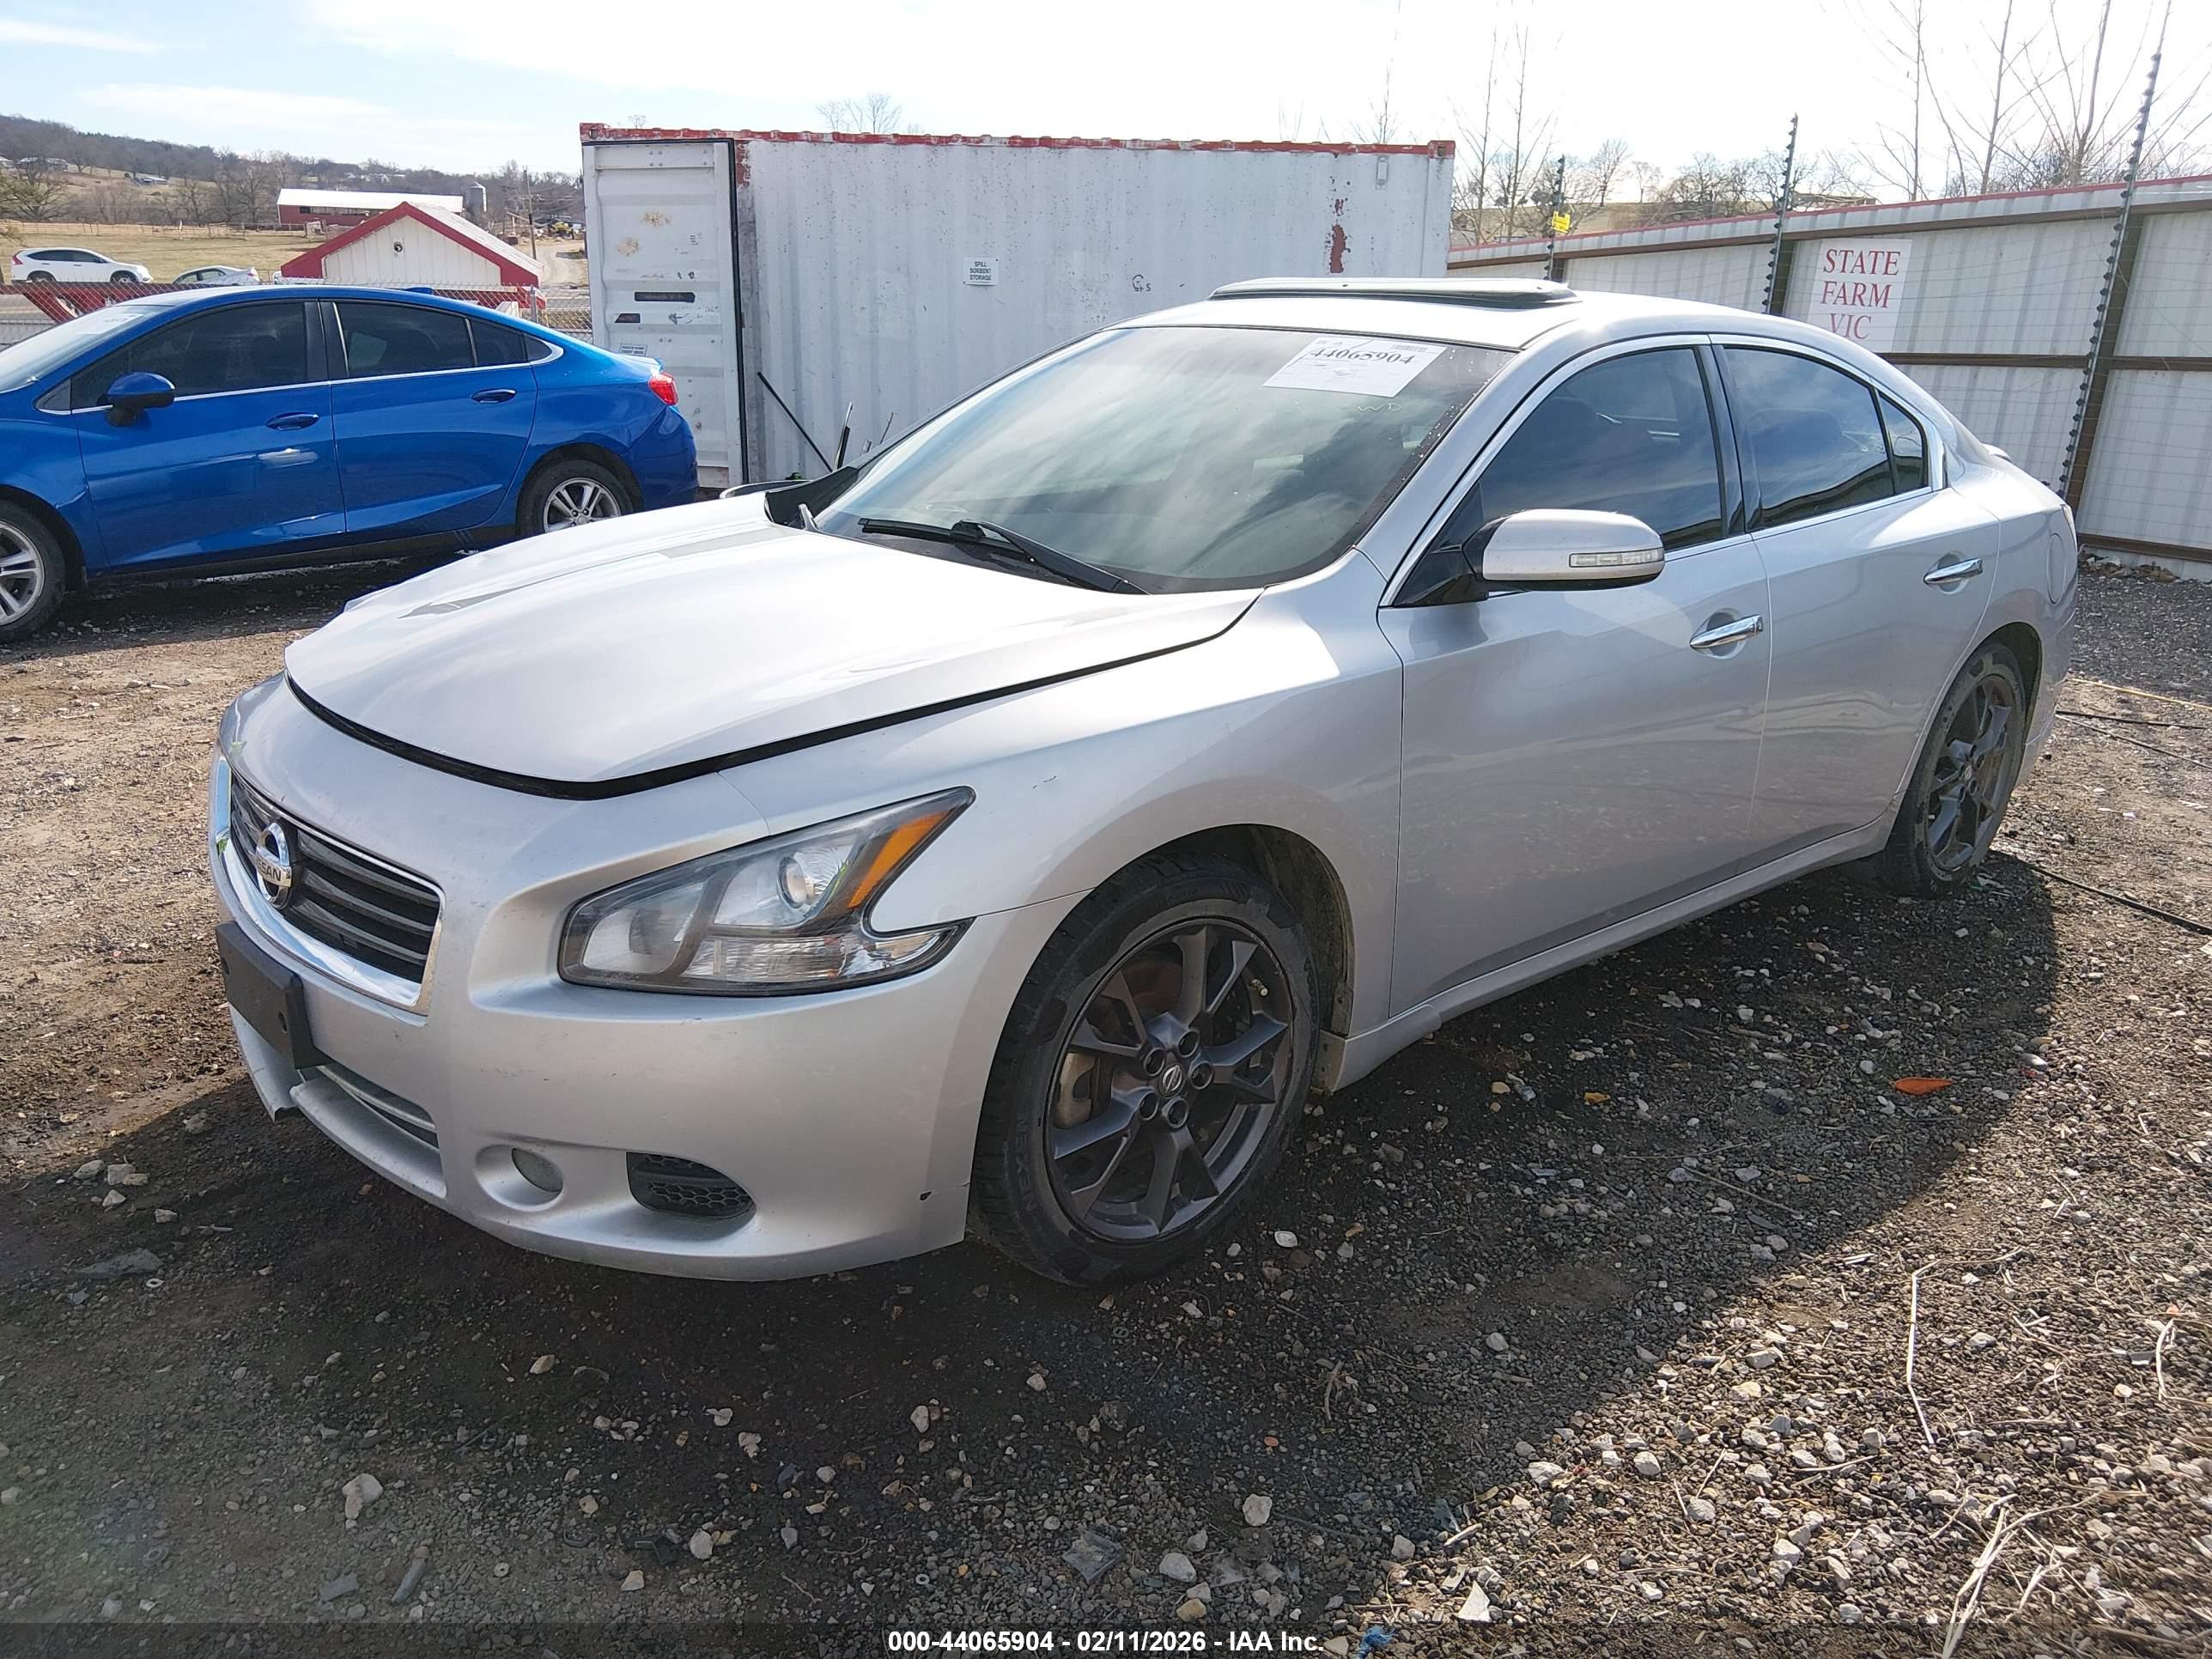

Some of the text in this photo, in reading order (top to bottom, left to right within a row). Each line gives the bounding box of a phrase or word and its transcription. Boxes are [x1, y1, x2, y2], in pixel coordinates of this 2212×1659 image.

[1823, 248, 1901, 276] STATE
[1820, 281, 1892, 308] FARM
[1830, 313, 1872, 339] VIC
[1310, 348, 1416, 365] 44065904
